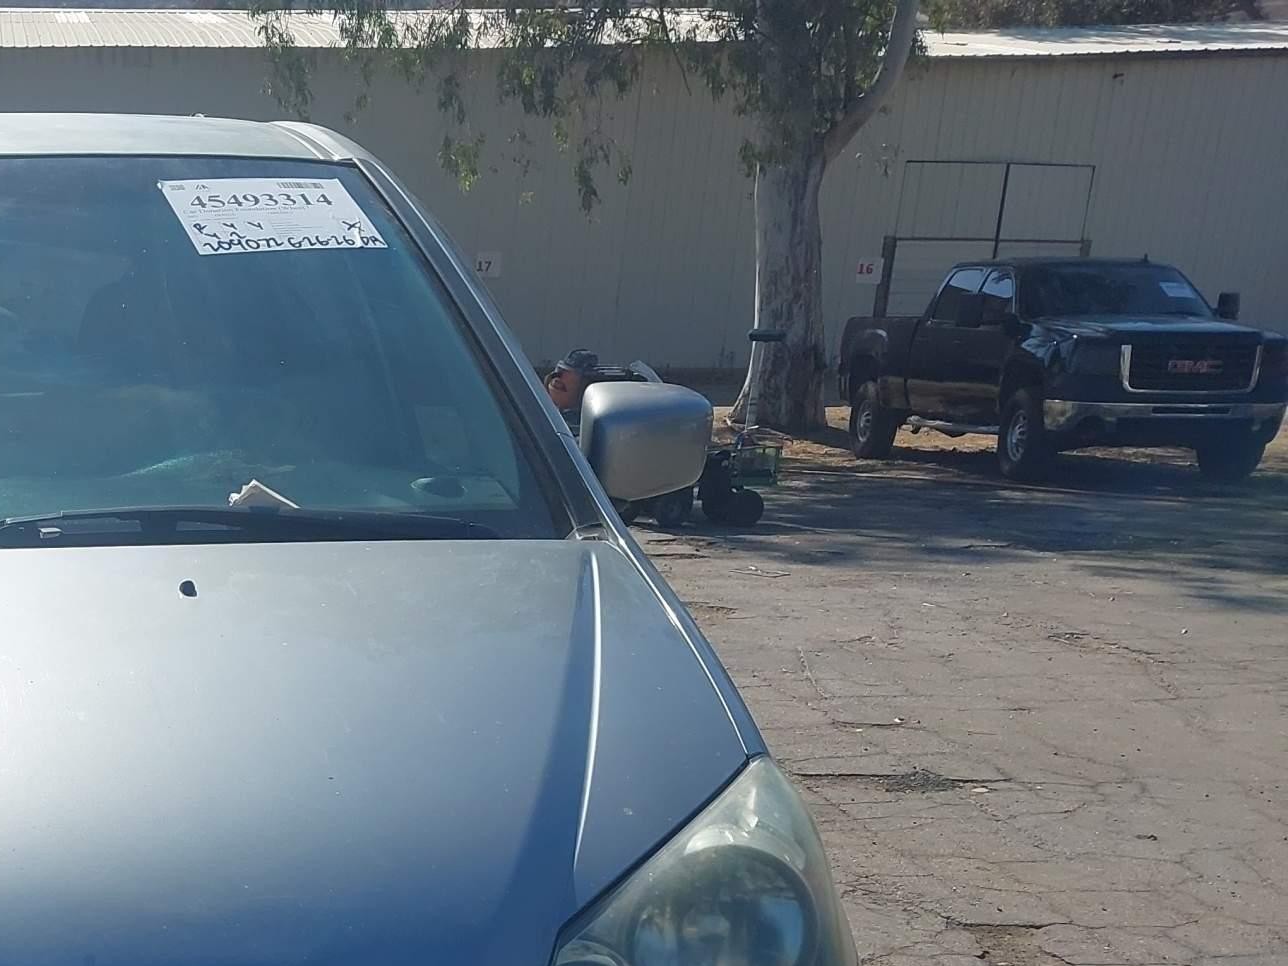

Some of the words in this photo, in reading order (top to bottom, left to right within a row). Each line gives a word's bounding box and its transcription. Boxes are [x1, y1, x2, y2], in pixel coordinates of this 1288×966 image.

[191, 193, 332, 209] 45493314
[477, 260, 492, 272] 17
[857, 263, 873, 274] 16
